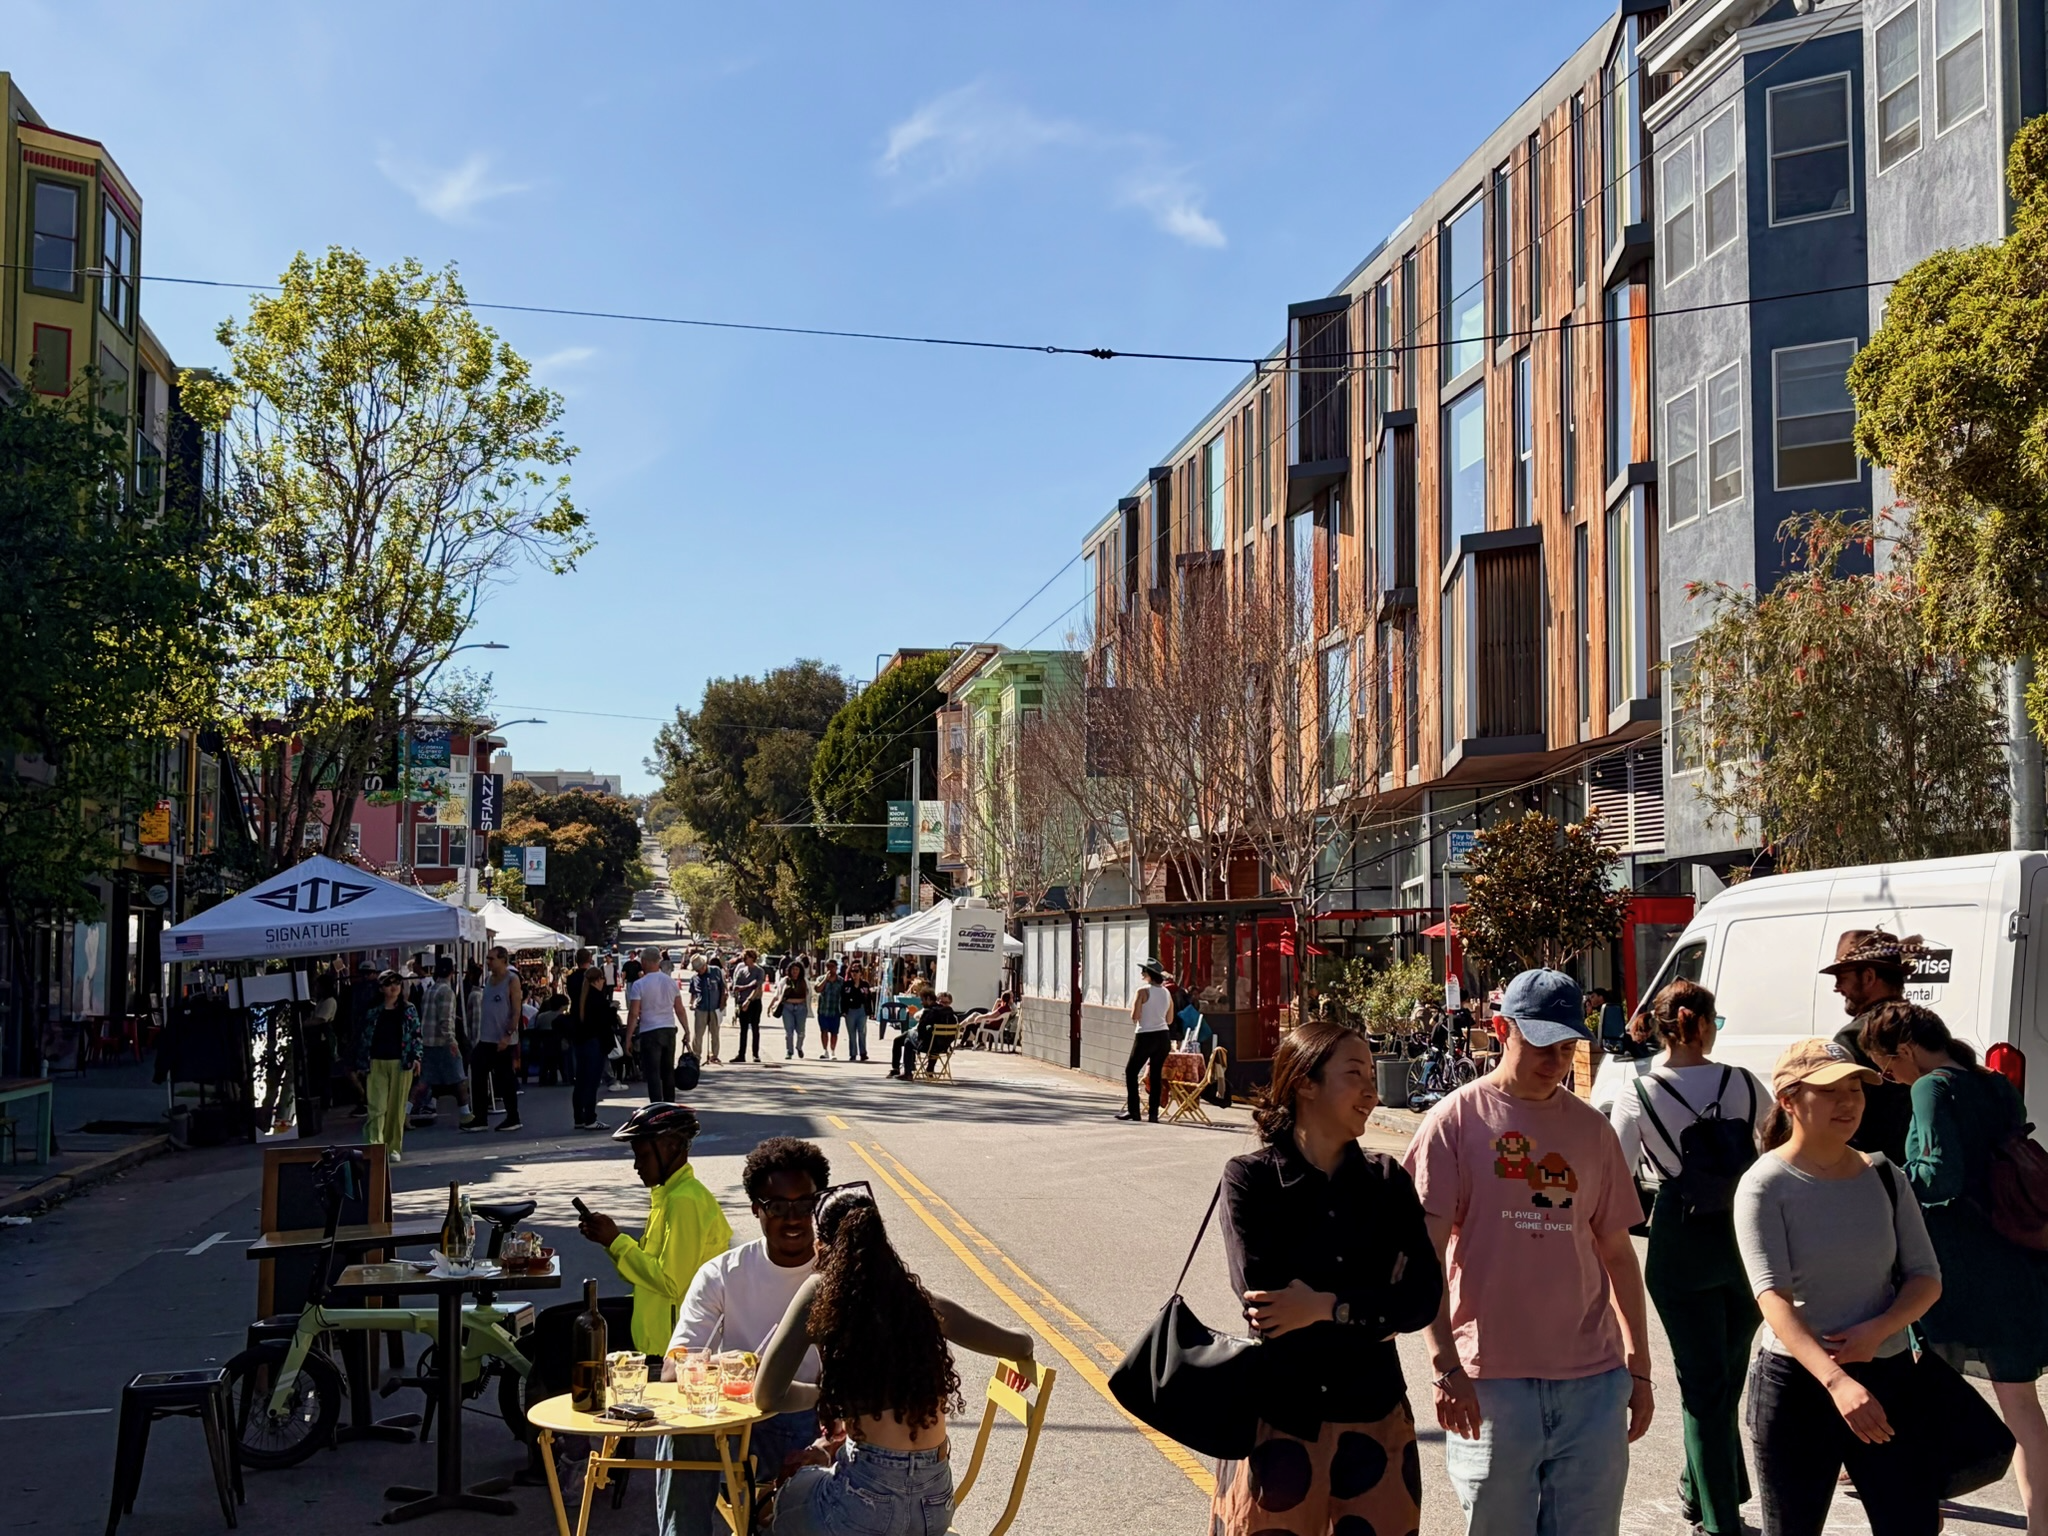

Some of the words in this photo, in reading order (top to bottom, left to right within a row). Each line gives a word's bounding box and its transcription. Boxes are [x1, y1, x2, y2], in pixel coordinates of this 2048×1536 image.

[481, 775, 495, 830] SFJAZZ
[1451, 833, 1465, 841] Pay
[1465, 833, 1474, 842] by
[249, 877, 377, 914] SIG
[265, 922, 350, 943] SIGNATURE
[1501, 1210, 1542, 1220] PLAYER
[1514, 1221, 1542, 1230] GAME
[1544, 1222, 1573, 1232] OVER
